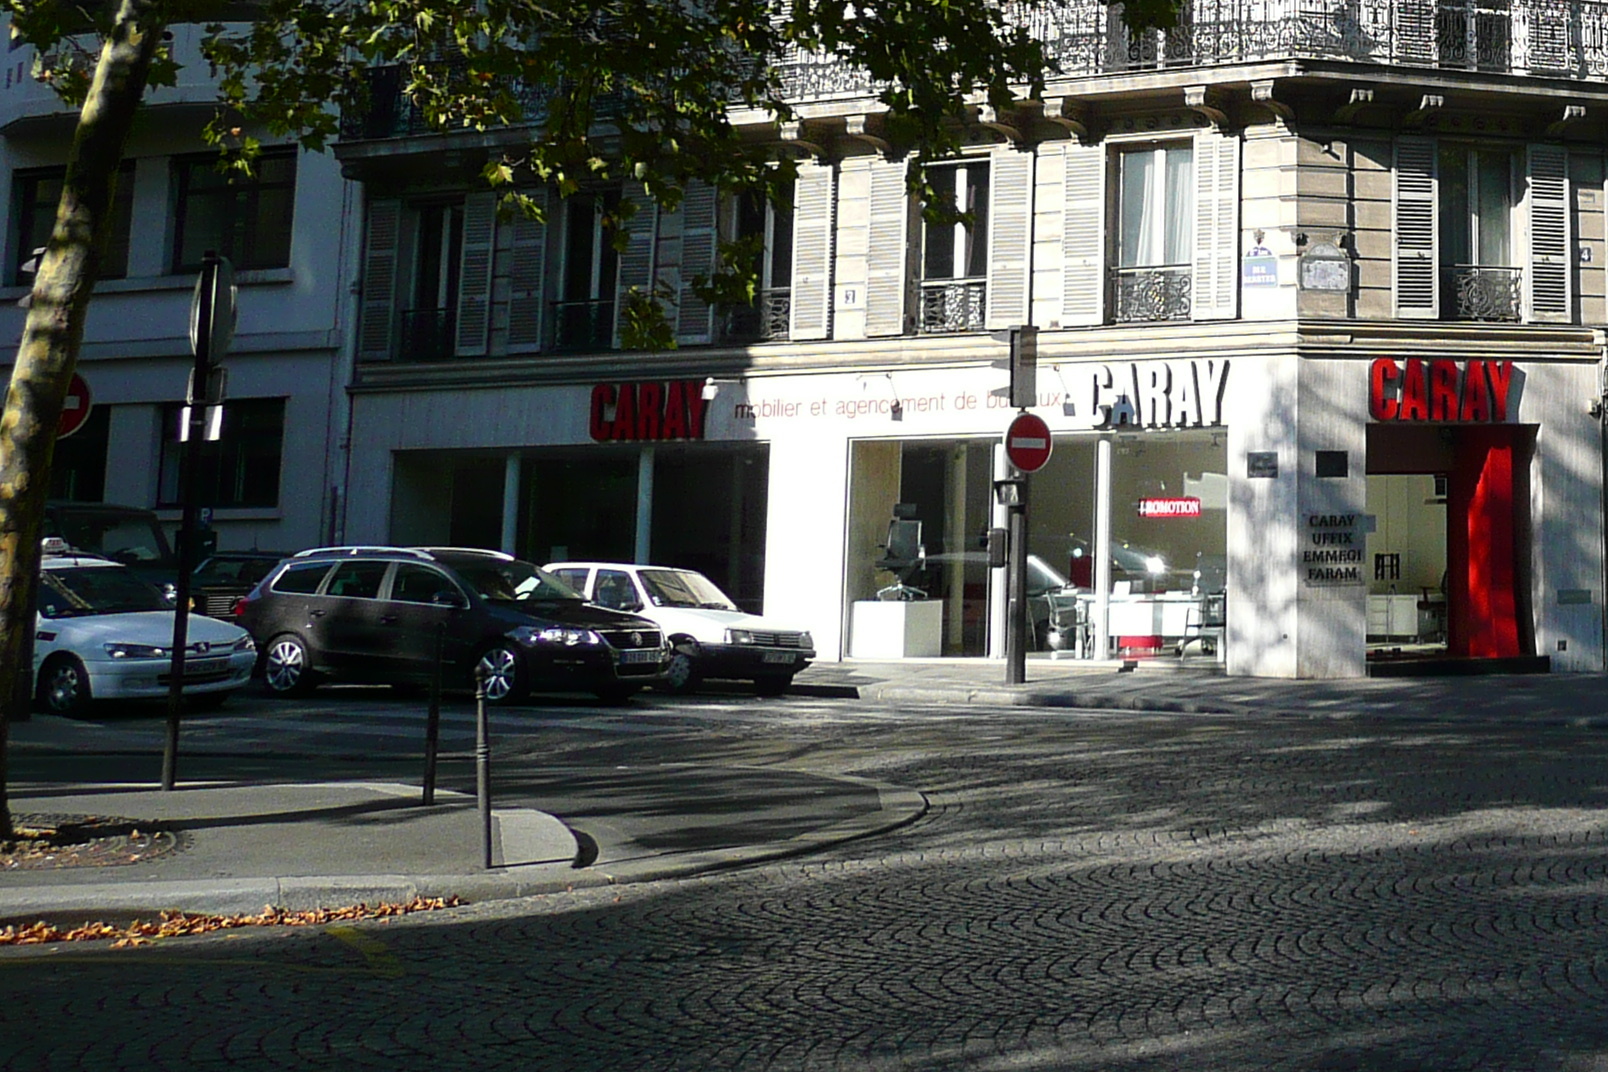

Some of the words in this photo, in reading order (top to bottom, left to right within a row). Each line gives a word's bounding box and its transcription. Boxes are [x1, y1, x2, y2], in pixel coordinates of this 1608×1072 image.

[1581, 248, 1590, 261] 4
[735, 398, 802, 419] mobilier
[810, 398, 828, 416] et
[836, 392, 945, 419] agencement
[954, 391, 978, 410] de
[986, 389, 1061, 409] buux
[1086, 359, 1230, 429] CARAY
[1368, 357, 1514, 421] CARAY
[590, 380, 708, 442] CARAY
[1309, 515, 1355, 527] CARAY
[1308, 567, 1358, 580] FARAM
